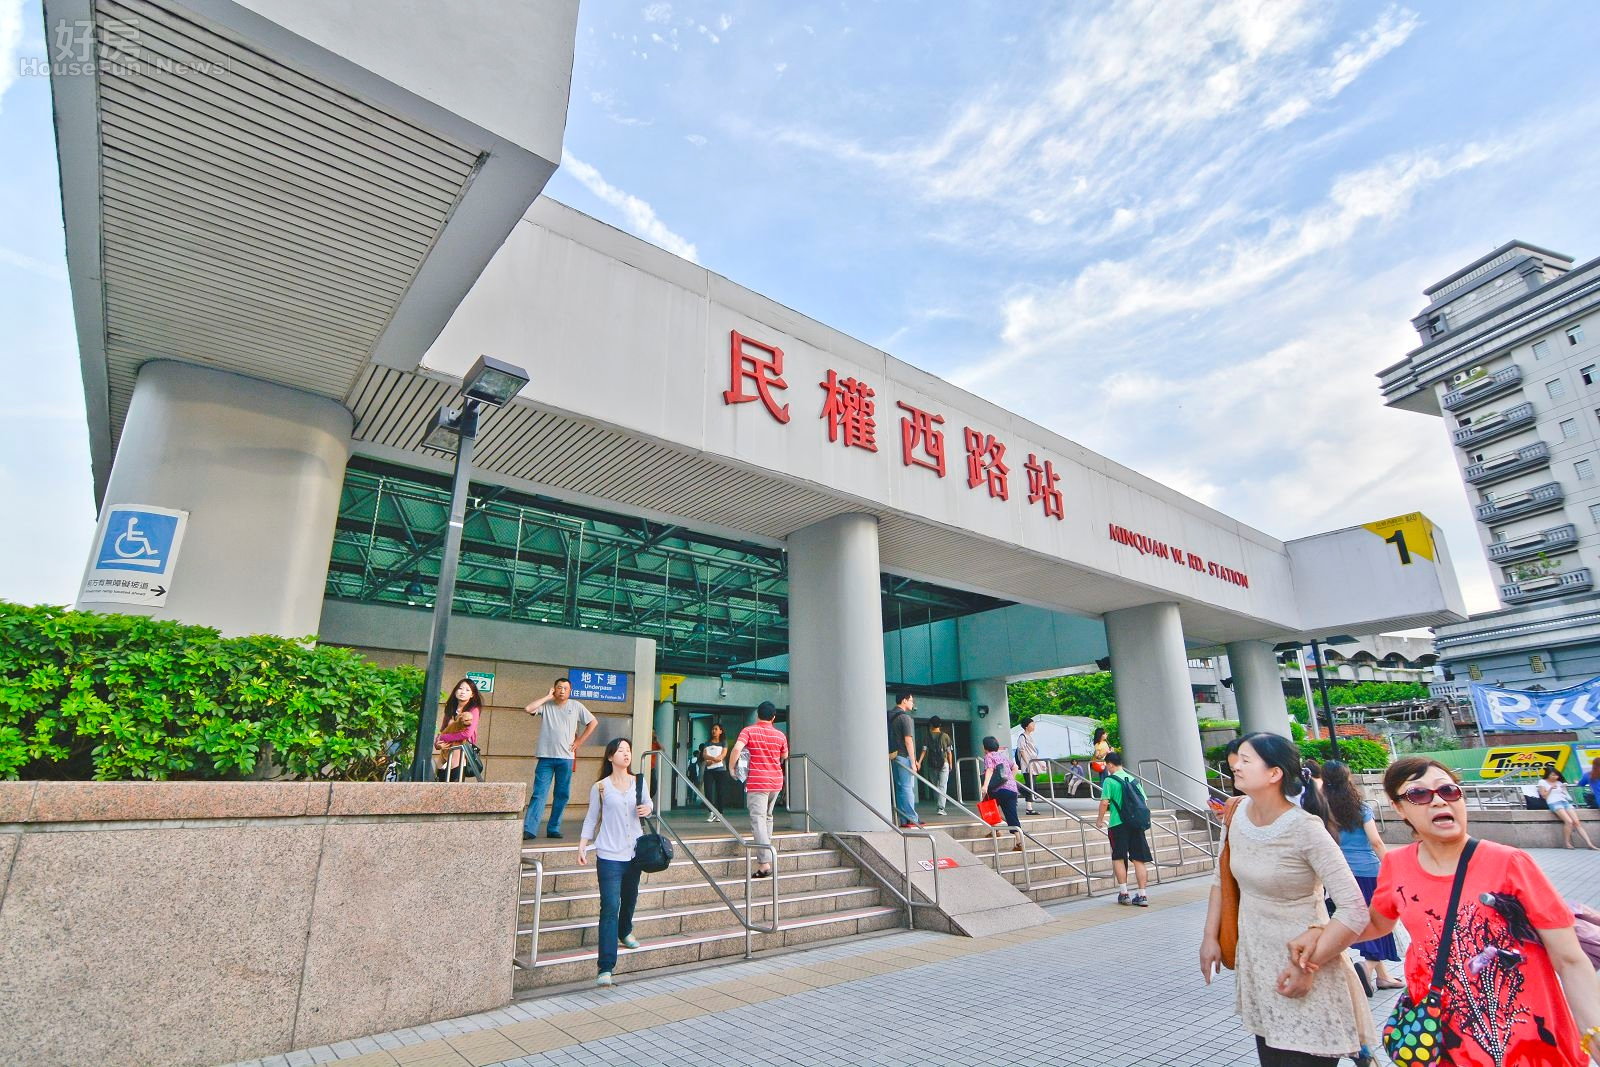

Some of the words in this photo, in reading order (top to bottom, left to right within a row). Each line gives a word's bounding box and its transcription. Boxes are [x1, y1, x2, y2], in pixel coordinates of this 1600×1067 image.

[722, 328, 1064, 521] 民權西路站
[1109, 523, 1169, 560] MINQUAN
[1170, 546, 1186, 566] W.
[1187, 552, 1207, 573] RD.
[1207, 561, 1249, 589] STATION
[1385, 530, 1412, 565] 1
[580, 671, 617, 686] 地下道
[584, 683, 612, 691] Underpass
[669, 683, 678, 703] 1
[1484, 690, 1531, 724] P
[1494, 758, 1555, 773] Times
